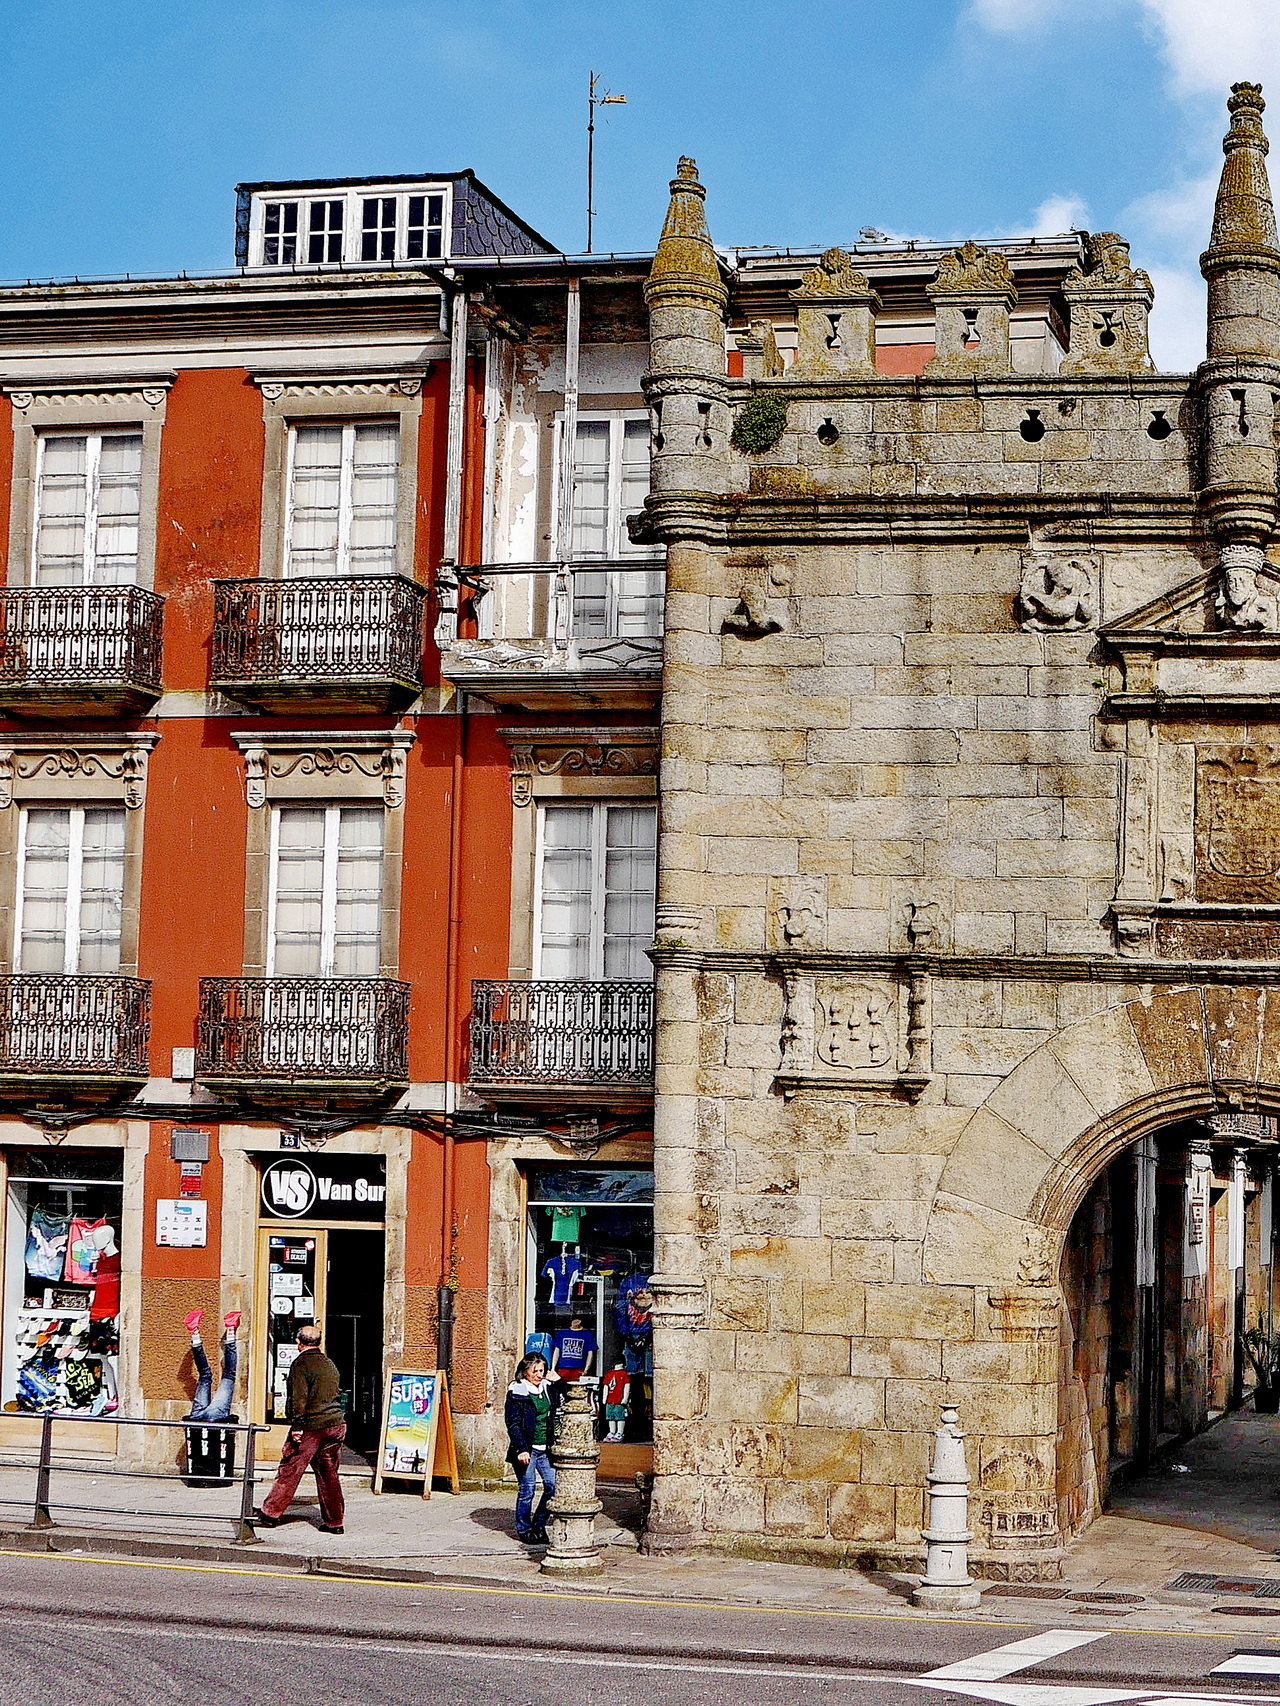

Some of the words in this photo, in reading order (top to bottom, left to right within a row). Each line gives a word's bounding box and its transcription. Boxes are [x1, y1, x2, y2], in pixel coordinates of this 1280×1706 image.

[284, 1135, 295, 1146] 33
[269, 1170, 311, 1211] VS
[317, 1177, 353, 1201] Van
[75, 1373, 95, 1391] SEA
[391, 1380, 433, 1404] SURF
